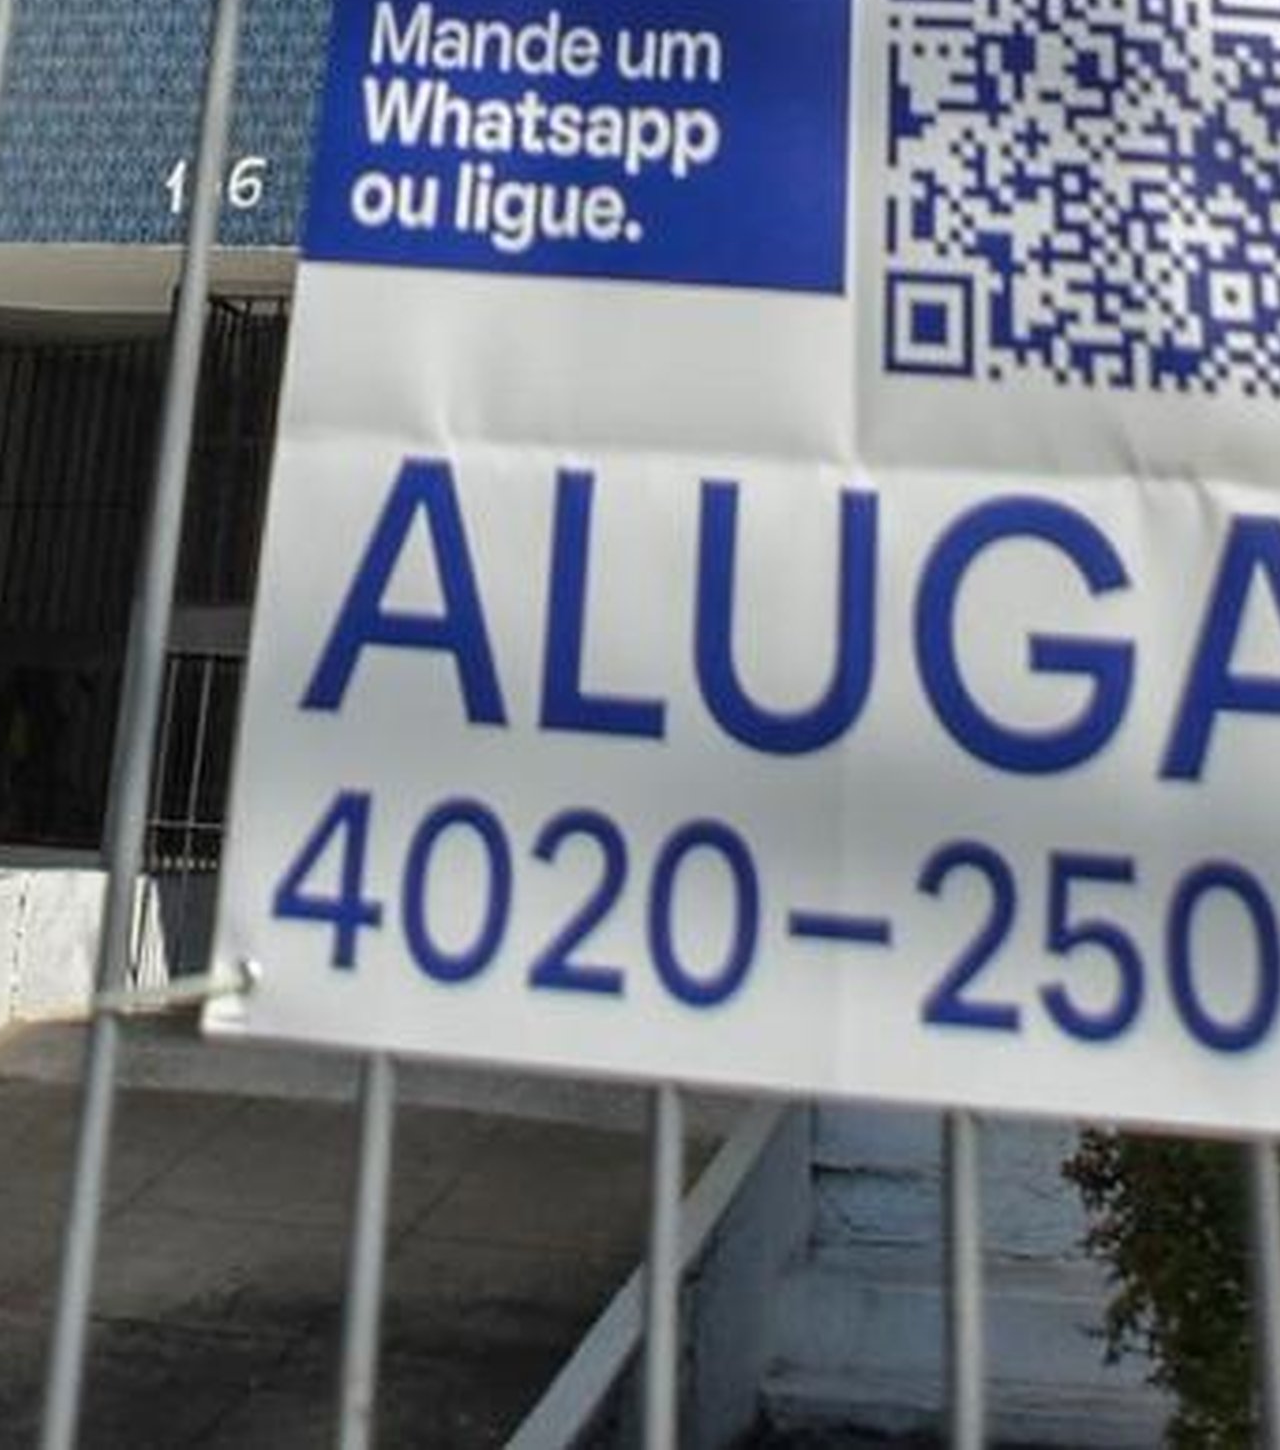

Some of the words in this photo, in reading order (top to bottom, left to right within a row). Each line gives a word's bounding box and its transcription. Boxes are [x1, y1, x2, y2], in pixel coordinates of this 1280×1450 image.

[370, 0, 601, 78] Mande
[616, 28, 722, 82] um
[362, 75, 721, 178] Whatsapp
[165, 156, 267, 214] 16
[350, 170, 439, 229] ou
[455, 160, 643, 254] ligue.
